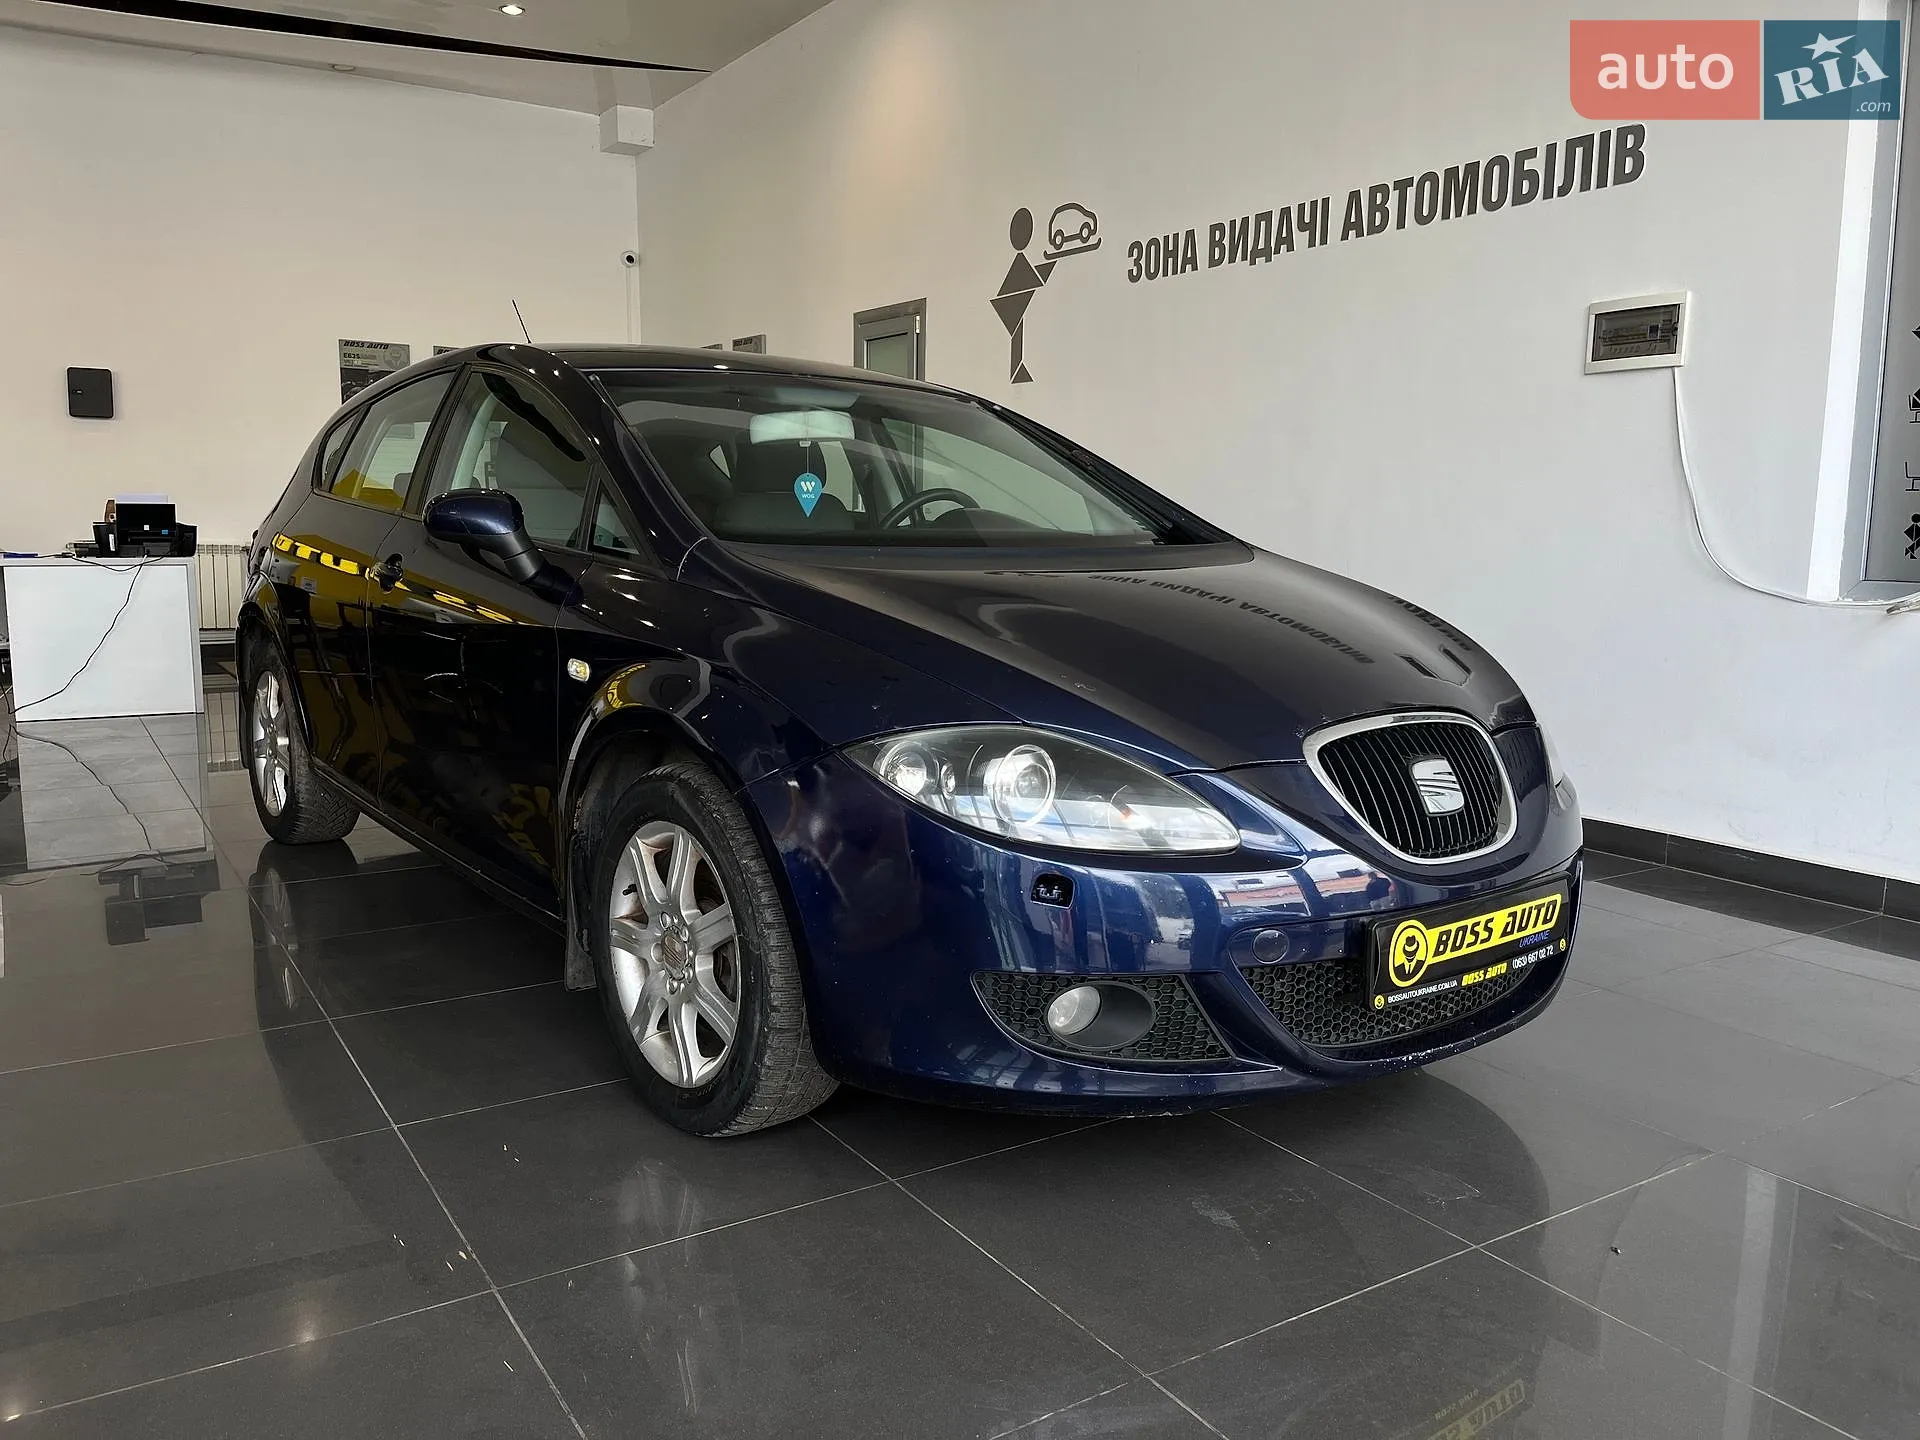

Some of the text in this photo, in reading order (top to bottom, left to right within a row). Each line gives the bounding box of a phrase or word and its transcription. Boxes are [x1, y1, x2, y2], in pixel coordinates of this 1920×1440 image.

[1127, 122, 1647, 283] ЗОНА ВИДАЧІ АВТОМОБІЛІВ
[1432, 899, 1558, 958] BOSS AUTO
[1519, 929, 1551, 948] UKRAINE
[1461, 962, 1508, 987] BOSS AUTO
